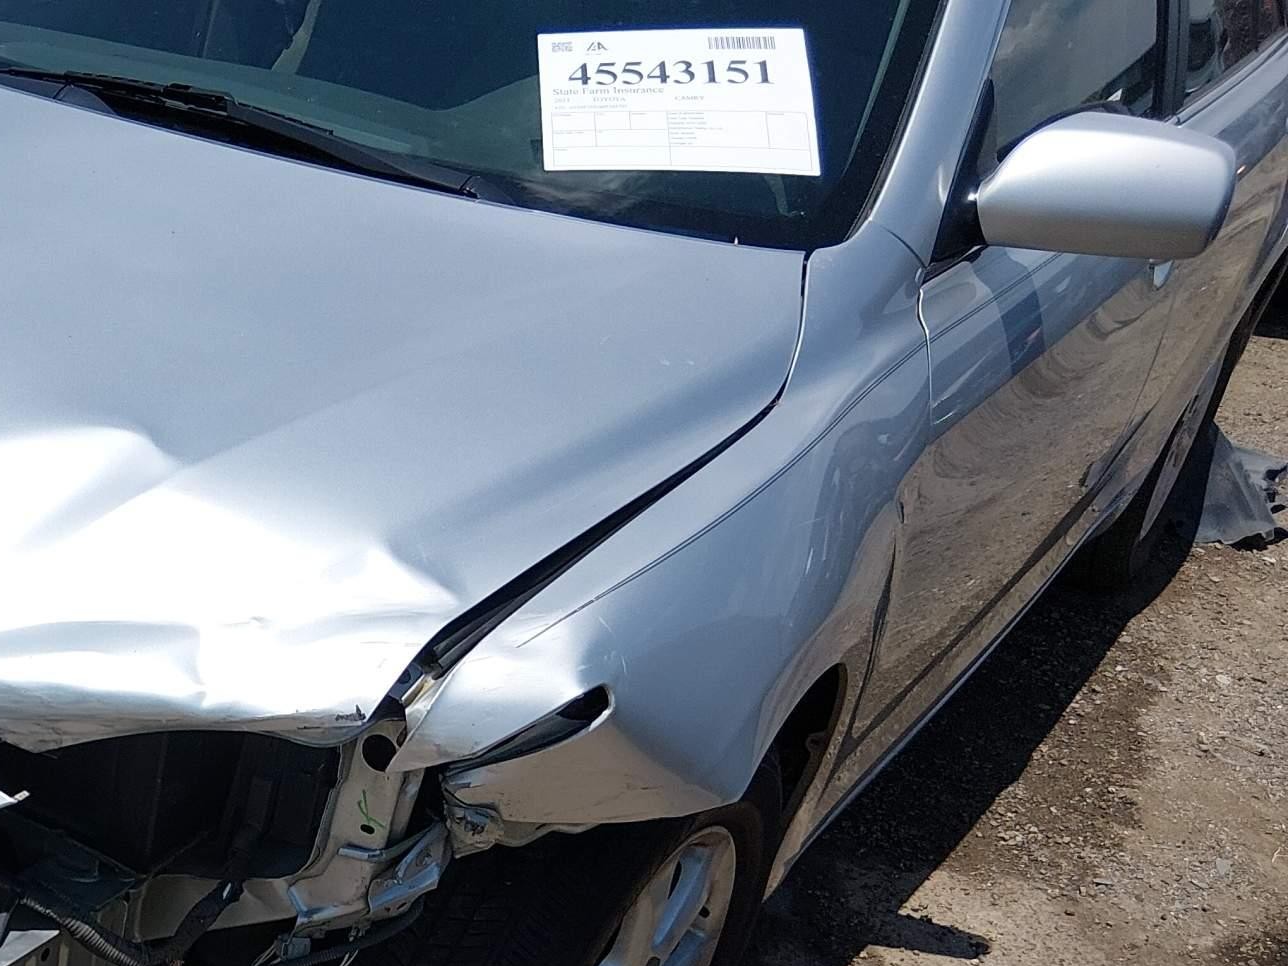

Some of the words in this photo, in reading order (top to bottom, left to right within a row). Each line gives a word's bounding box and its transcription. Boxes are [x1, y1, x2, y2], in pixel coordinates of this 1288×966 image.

[568, 59, 775, 86] 45543151
[552, 88, 579, 96] State
[582, 87, 610, 95] Farm
[613, 86, 665, 94] Insurance
